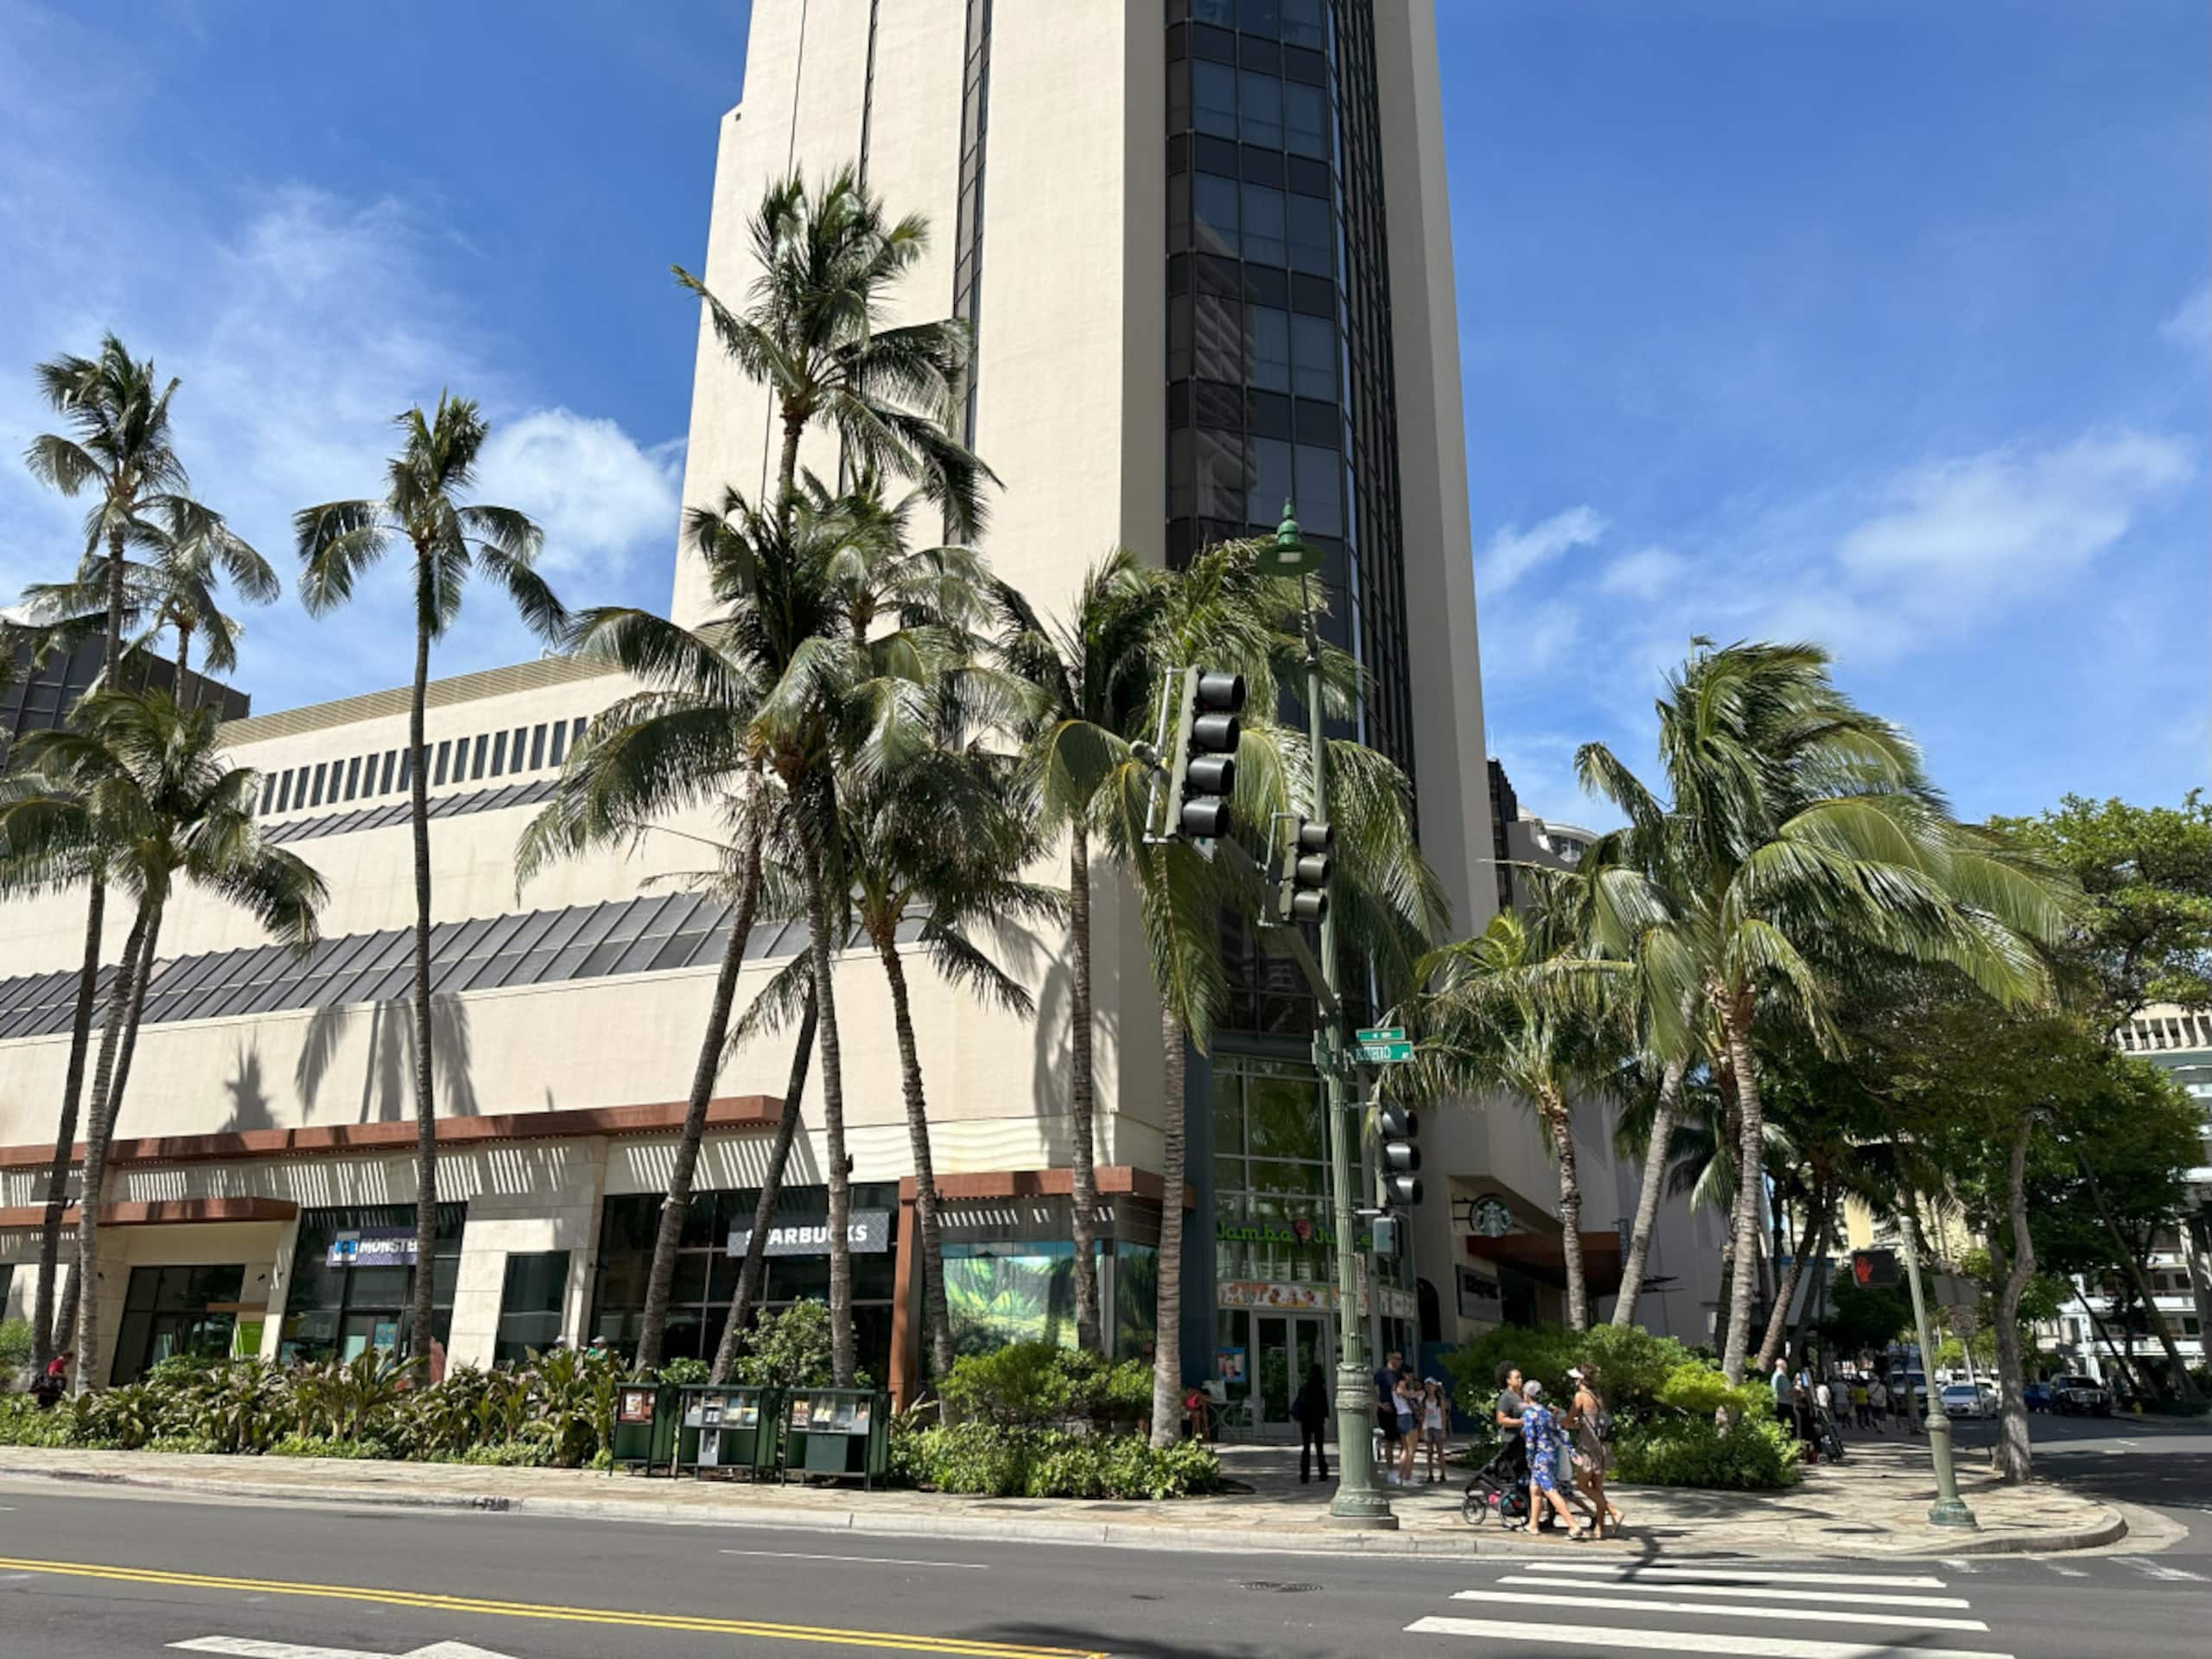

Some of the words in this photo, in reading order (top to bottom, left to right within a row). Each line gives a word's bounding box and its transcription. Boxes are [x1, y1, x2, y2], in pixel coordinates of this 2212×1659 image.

[746, 1224, 868, 1246] SARBUKS
[1217, 1218, 1294, 1243] Jamba
[1314, 1226, 1372, 1245] Jue
[359, 1237, 419, 1254] MONSTE
